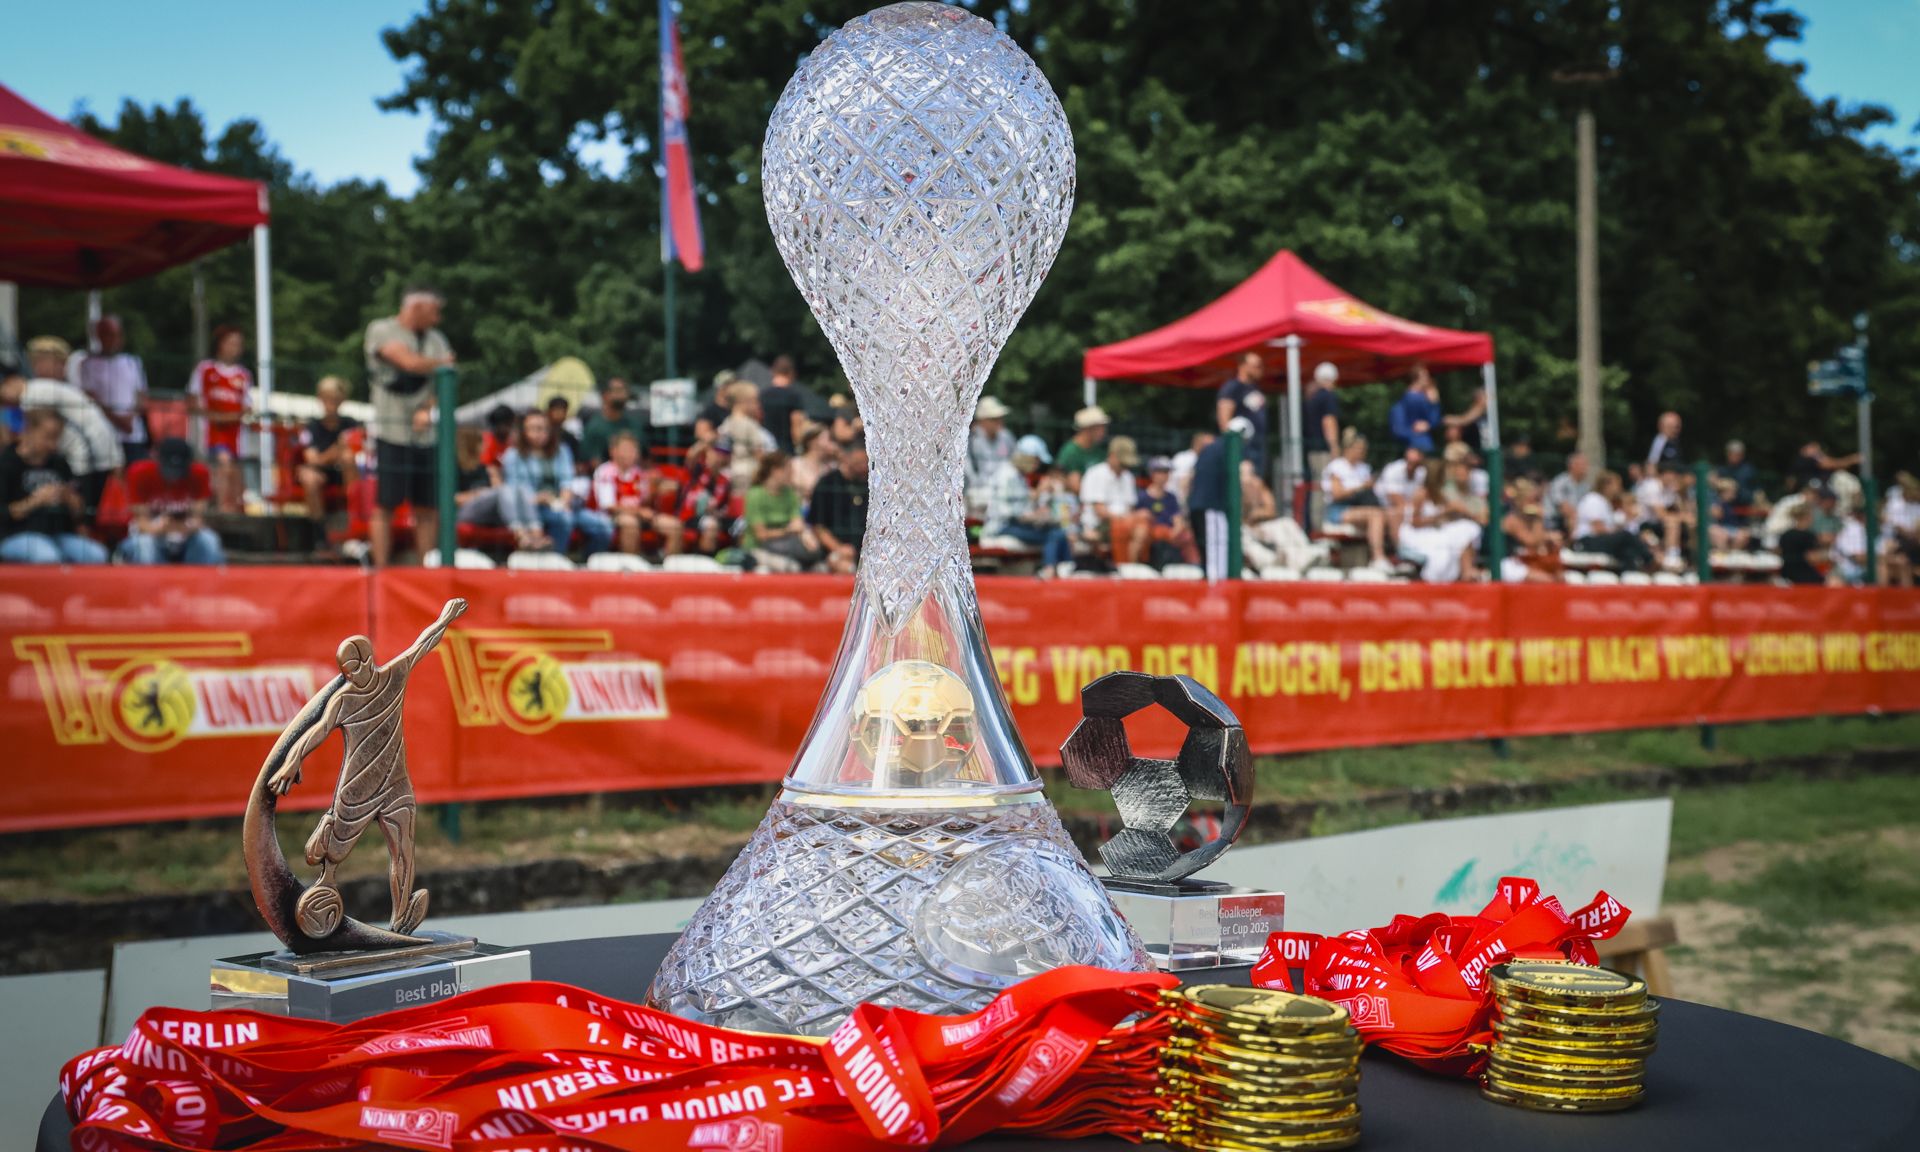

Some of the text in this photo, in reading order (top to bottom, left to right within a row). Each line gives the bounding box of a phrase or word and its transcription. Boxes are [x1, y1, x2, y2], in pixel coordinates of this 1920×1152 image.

[996, 645, 1040, 706] EG
[1231, 641, 1351, 700] AUGEN,
[1359, 639, 1424, 693] DEN
[1430, 637, 1516, 690] BLICK
[1587, 635, 1660, 682] NACH
[567, 671, 661, 713] UNION
[1219, 906, 1263, 920] Goalkeeper
[1232, 923, 1249, 938] Cup
[1250, 921, 1269, 934] 2025
[1571, 896, 1620, 930] BERL
[1274, 938, 1310, 960] ION
[395, 984, 426, 1004] Best
[121, 1027, 188, 1072] UNIO
[147, 1020, 259, 1048] ERLIN
[587, 1022, 610, 1044] 1.
[622, 1033, 657, 1057] FC
[623, 1010, 702, 1058] UNION
[496, 1071, 620, 1111] BERLIN
[660, 1085, 768, 1121] UNION
[773, 1076, 815, 1102] FC
[844, 1044, 911, 1136] UNION
